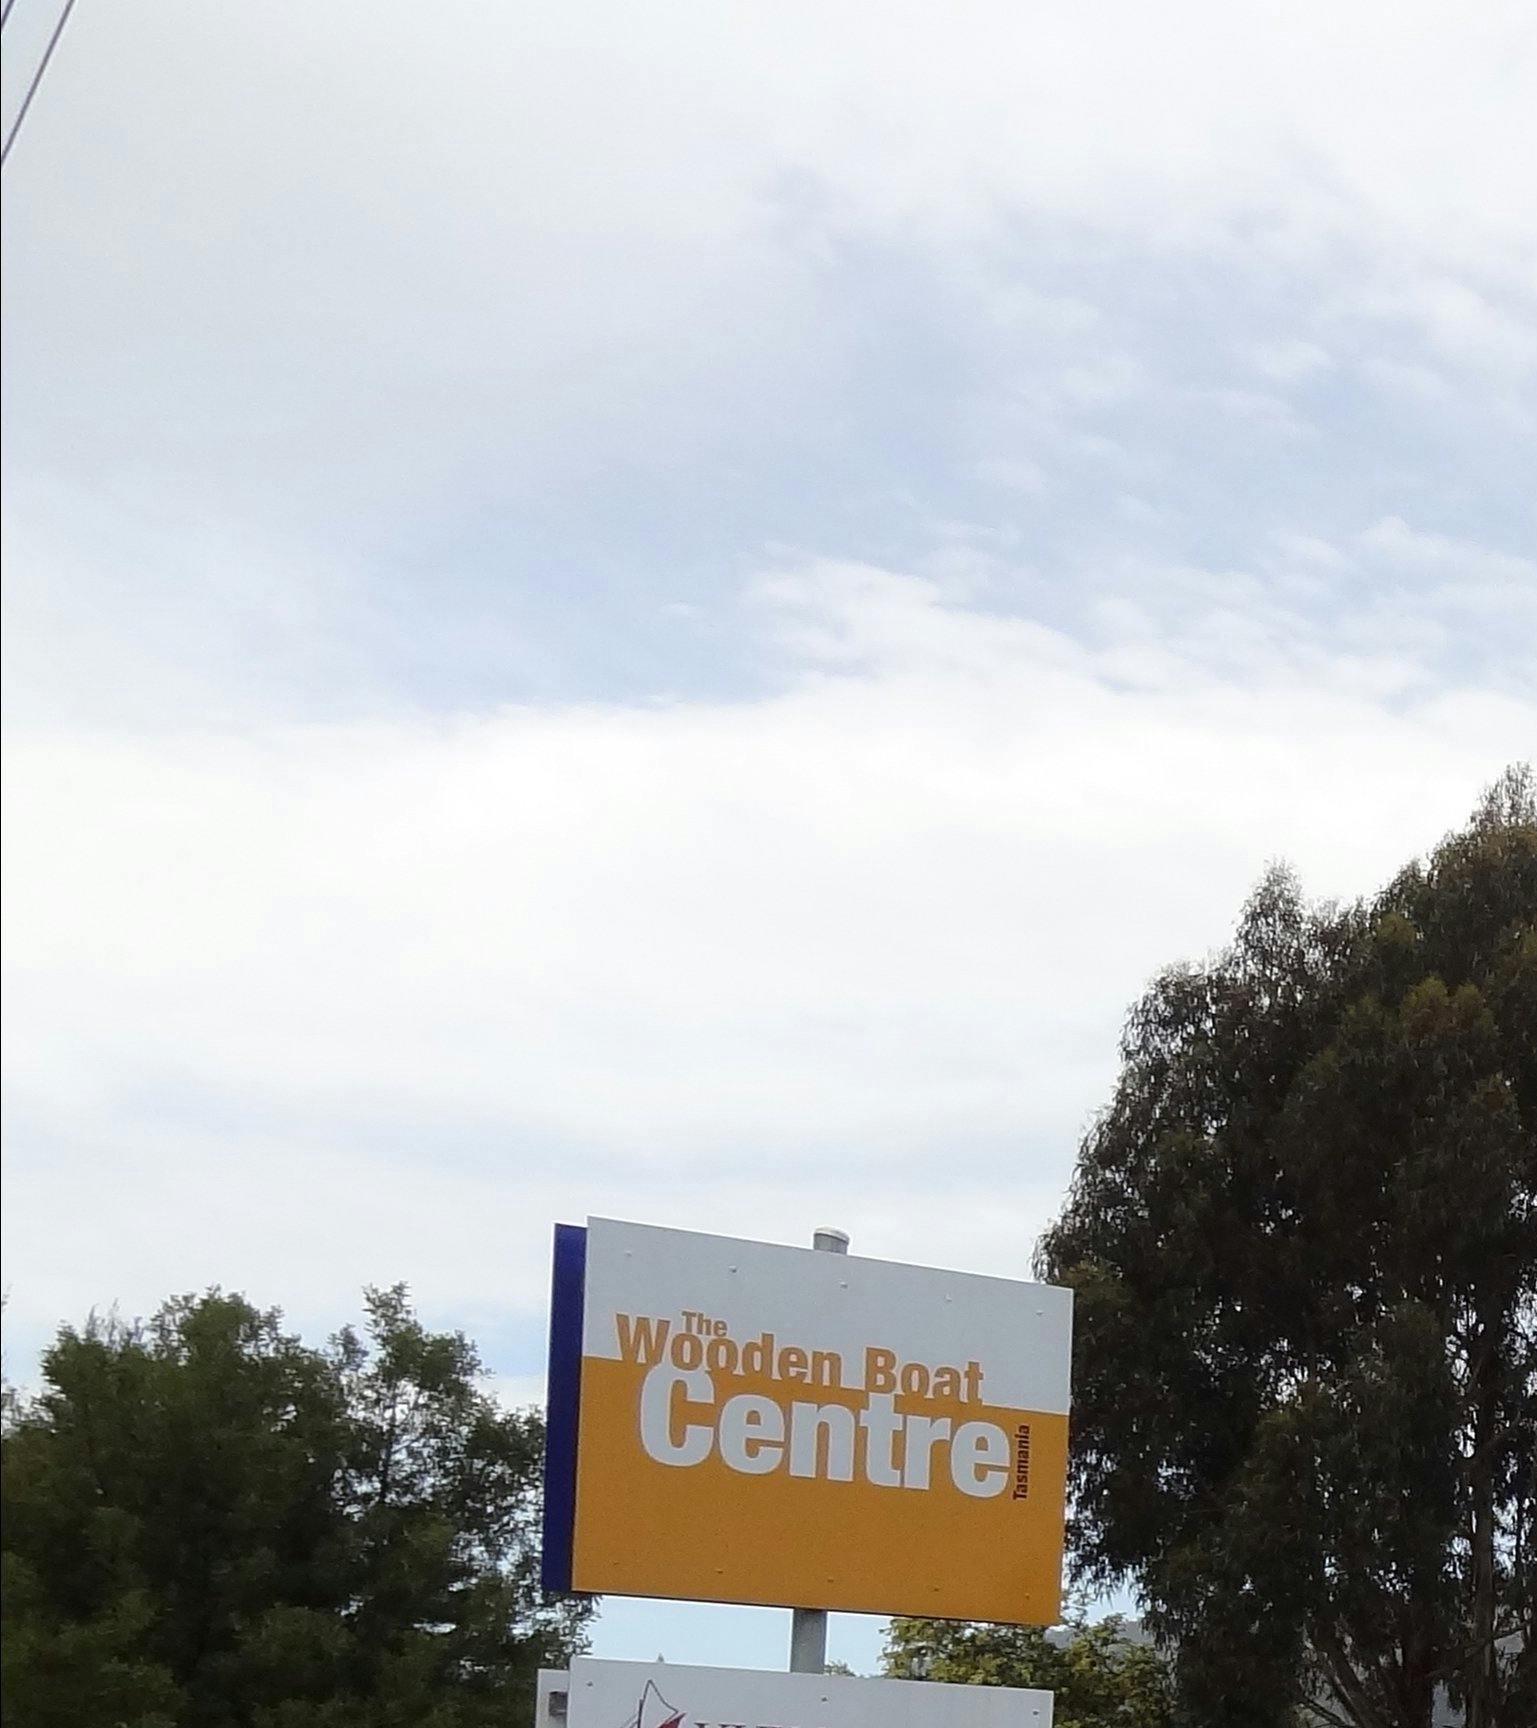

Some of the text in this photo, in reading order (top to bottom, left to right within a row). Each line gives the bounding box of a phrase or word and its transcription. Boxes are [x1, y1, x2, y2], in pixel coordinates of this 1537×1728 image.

[616, 1312, 985, 1405] Wooden Boat
[682, 1311, 728, 1337] The
[640, 1362, 1011, 1499] Centre
[1012, 1424, 1030, 1500] Tasmania
